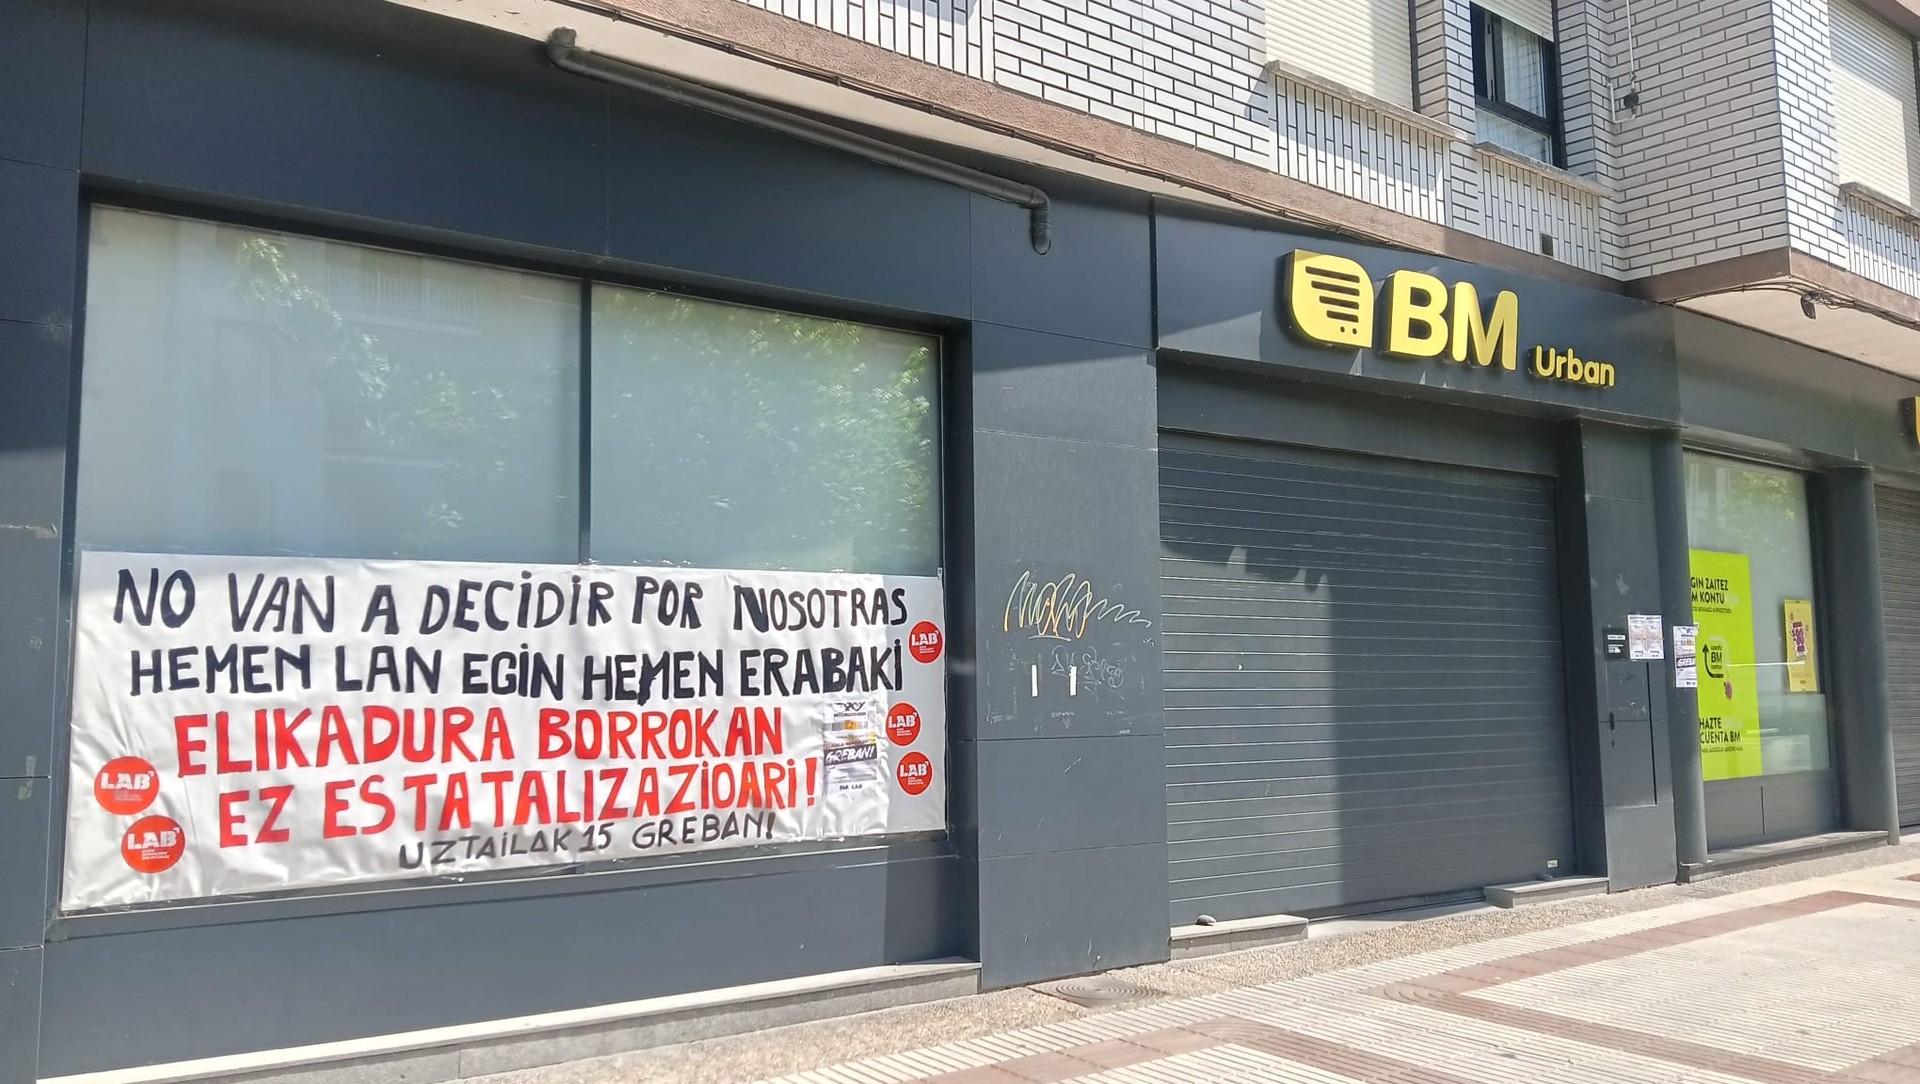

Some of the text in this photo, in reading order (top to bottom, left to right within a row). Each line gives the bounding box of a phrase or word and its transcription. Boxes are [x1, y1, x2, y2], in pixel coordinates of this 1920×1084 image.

[1389, 269, 1518, 371] BM
[1535, 344, 1614, 387] Urban
[1705, 578, 1728, 591] ZAITEZ
[113, 568, 907, 635] NO VAN A DECIDIR POR NOSOTRAS
[1700, 592, 1725, 604] KONTU
[911, 634, 938, 647] LAB
[1711, 652, 1722, 662] BM
[130, 638, 903, 705] HEMEN LAN EGIN HEMEN ERABAKI
[888, 715, 916, 729] LAB
[1699, 717, 1722, 730] HAZTE
[174, 705, 782, 777] ELIKADURA BORROKAN
[1700, 731, 1741, 744] CUENTA BM
[826, 746, 874, 763] GREBAN!
[900, 763, 928, 777] LAB
[101, 771, 154, 790] LAB
[219, 758, 818, 848] EZ ESTATALIZAZIOARI!
[127, 831, 179, 850] LAB
[399, 811, 776, 870] UZTAILAK 15 GREBAN!
